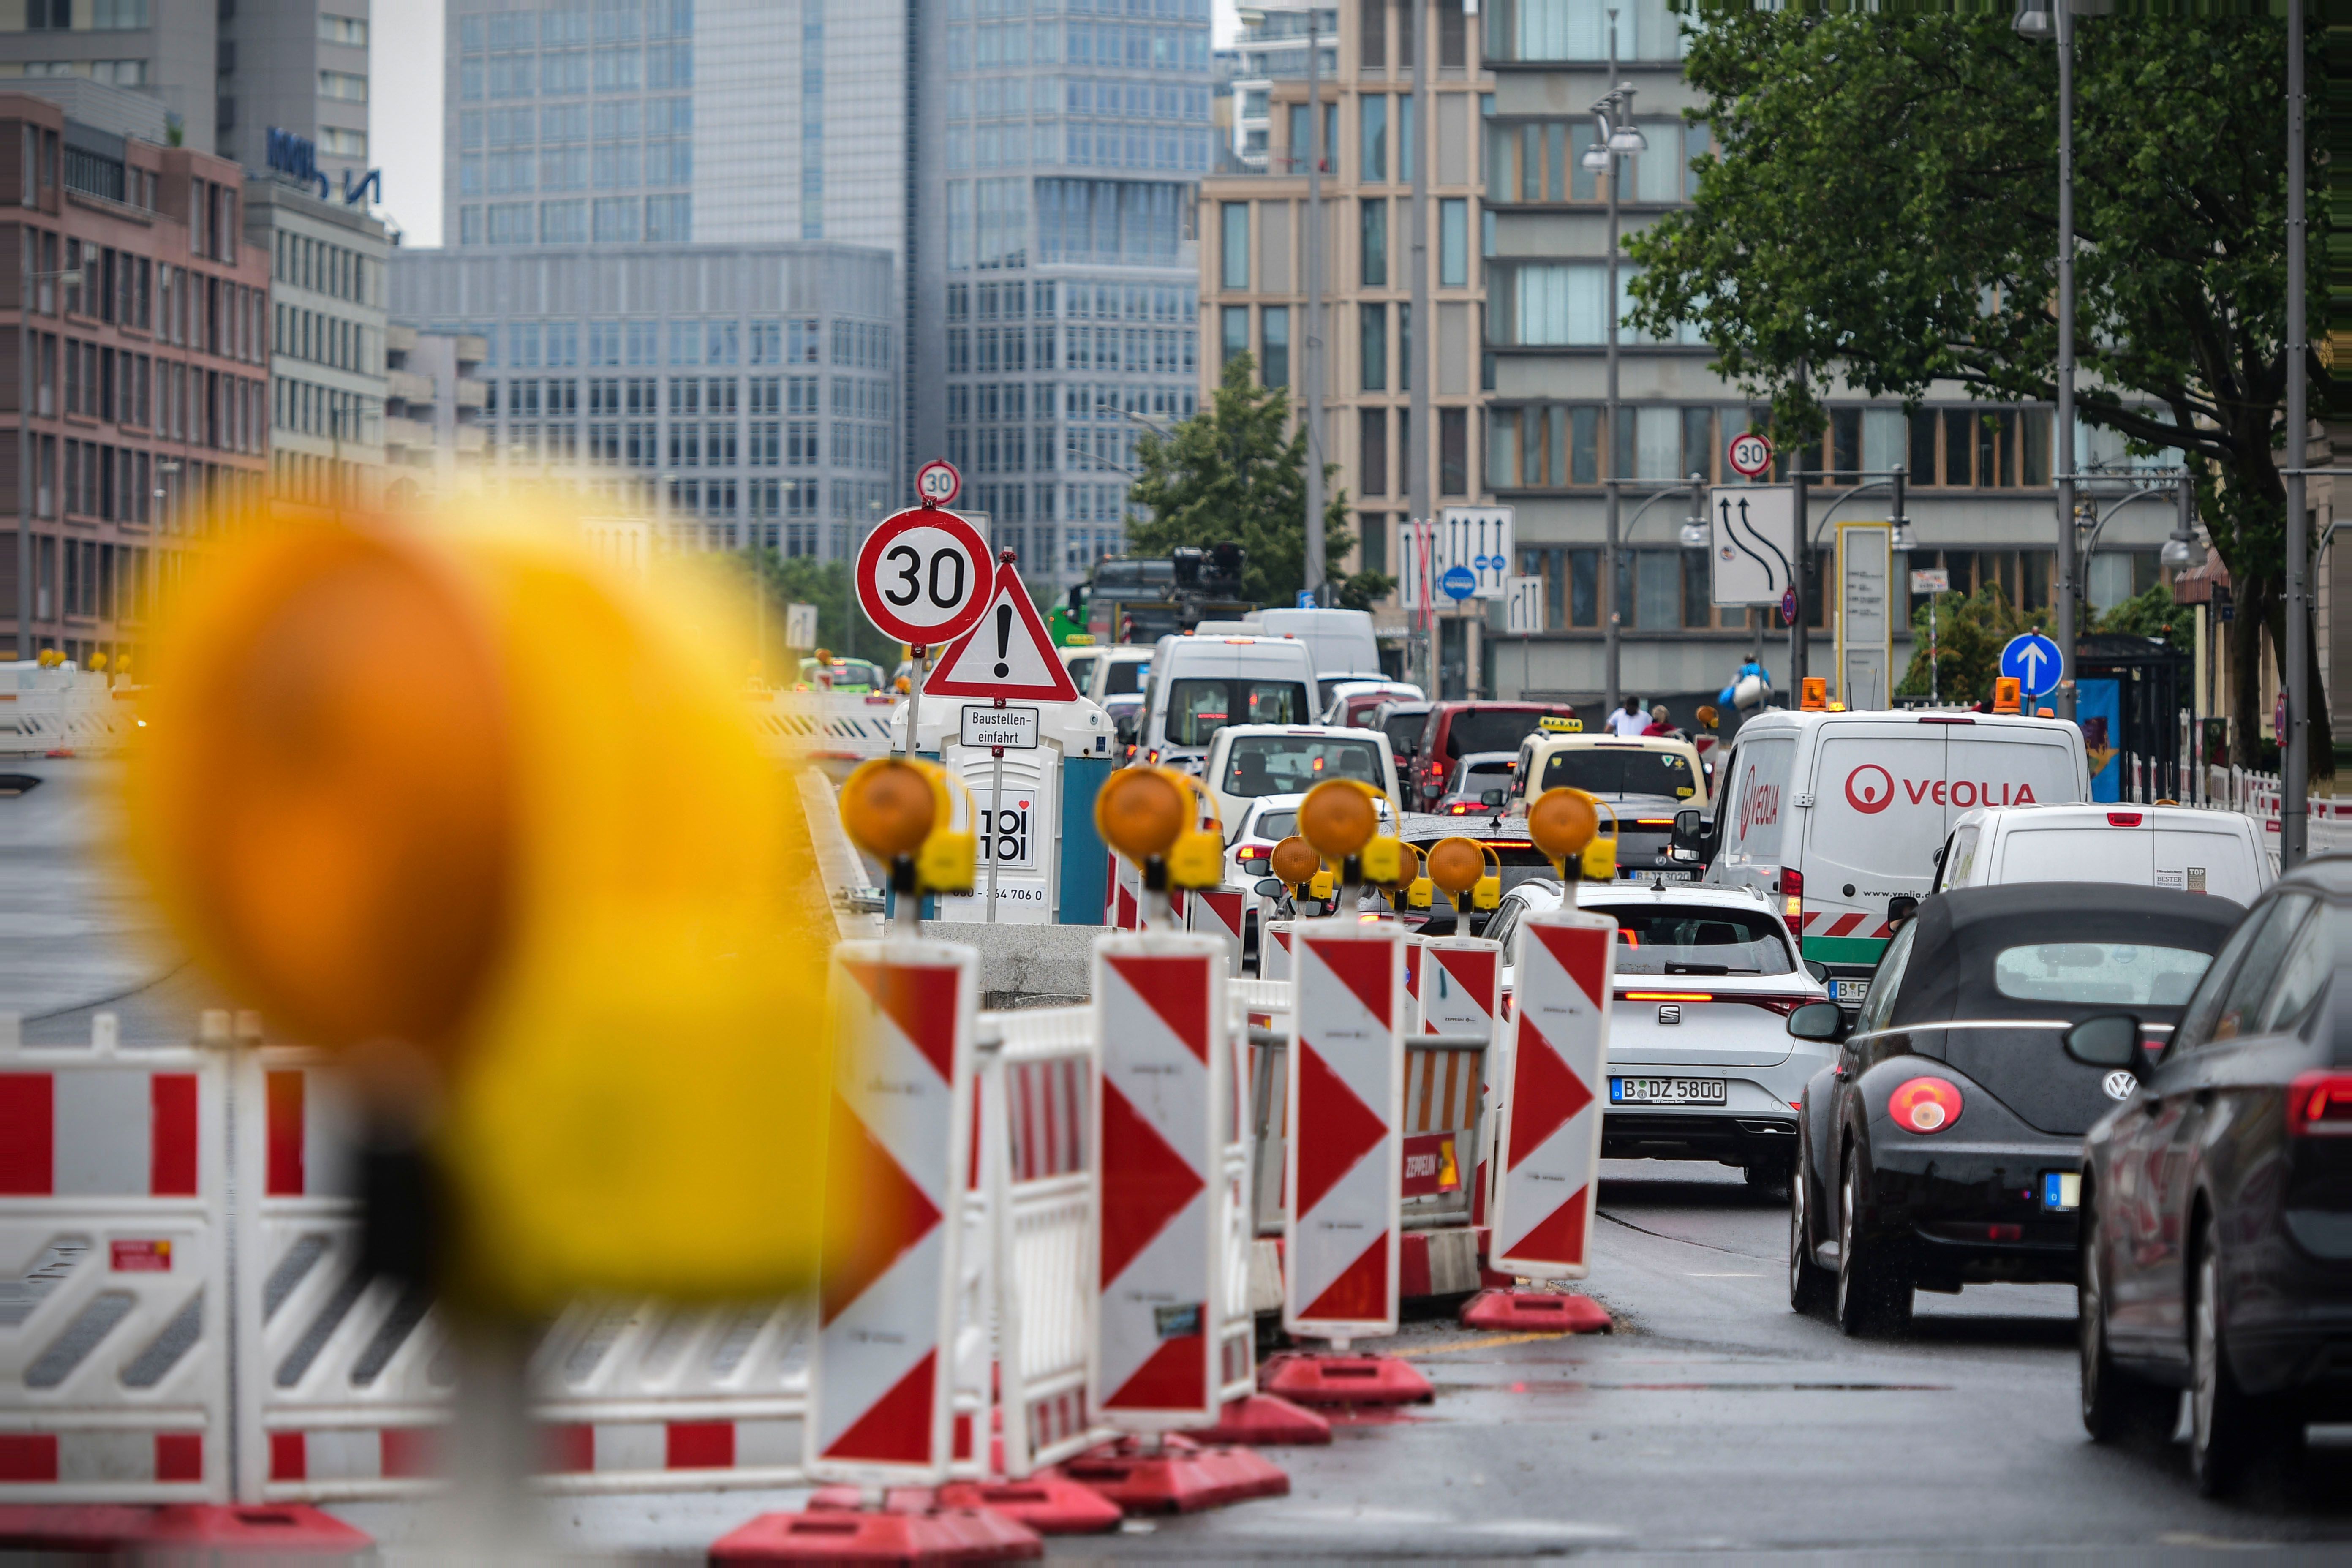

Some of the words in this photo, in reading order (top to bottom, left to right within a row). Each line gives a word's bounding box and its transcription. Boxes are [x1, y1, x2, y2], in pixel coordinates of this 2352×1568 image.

[1738, 444, 1763, 463] 30
[926, 473, 951, 492] 30
[885, 545, 965, 608] 30
[972, 712, 1032, 726] Baustellen-
[978, 730, 1018, 743] einfahrt
[986, 889, 1007, 899] 64
[1011, 889, 1032, 900] 706
[1035, 890, 1042, 900] 0
[1839, 983, 1848, 996] B
[1625, 1081, 1636, 1097] B
[1649, 1081, 1673, 1097] DZ
[1677, 1081, 1723, 1098] 5800
[1406, 1154, 1436, 1178] ZEPPELIN
